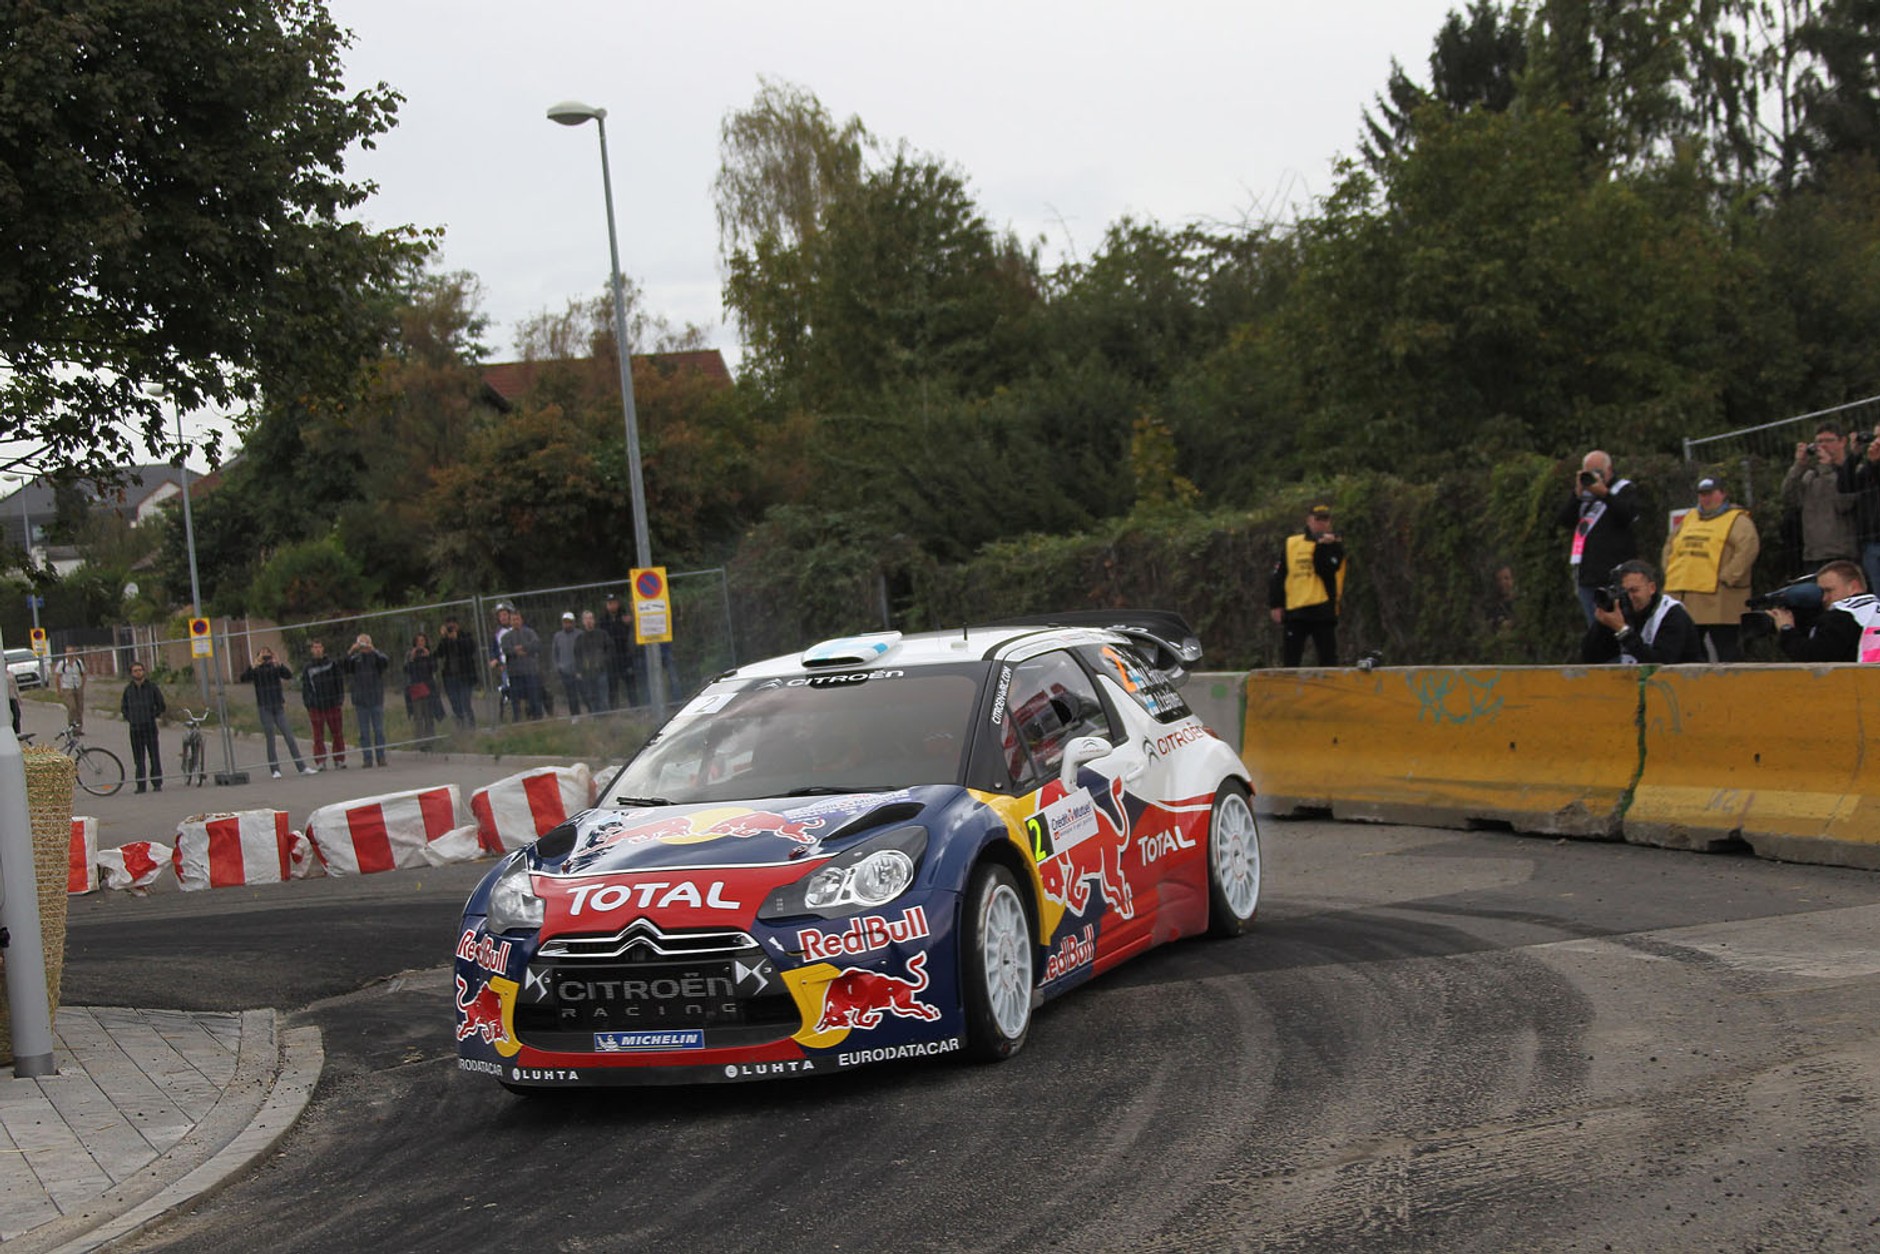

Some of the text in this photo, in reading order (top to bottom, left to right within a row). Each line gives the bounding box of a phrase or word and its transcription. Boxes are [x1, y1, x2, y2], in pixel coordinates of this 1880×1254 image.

[1027, 818, 1047, 862] 2
[1137, 825, 1197, 867] TOTAL
[567, 881, 741, 917] TOTAL
[621, 1033, 698, 1046] MICHELIN
[838, 1038, 960, 1067] EURODATACAR
[522, 1070, 580, 1081] LUHTA
[742, 1060, 815, 1076] LUHTA
